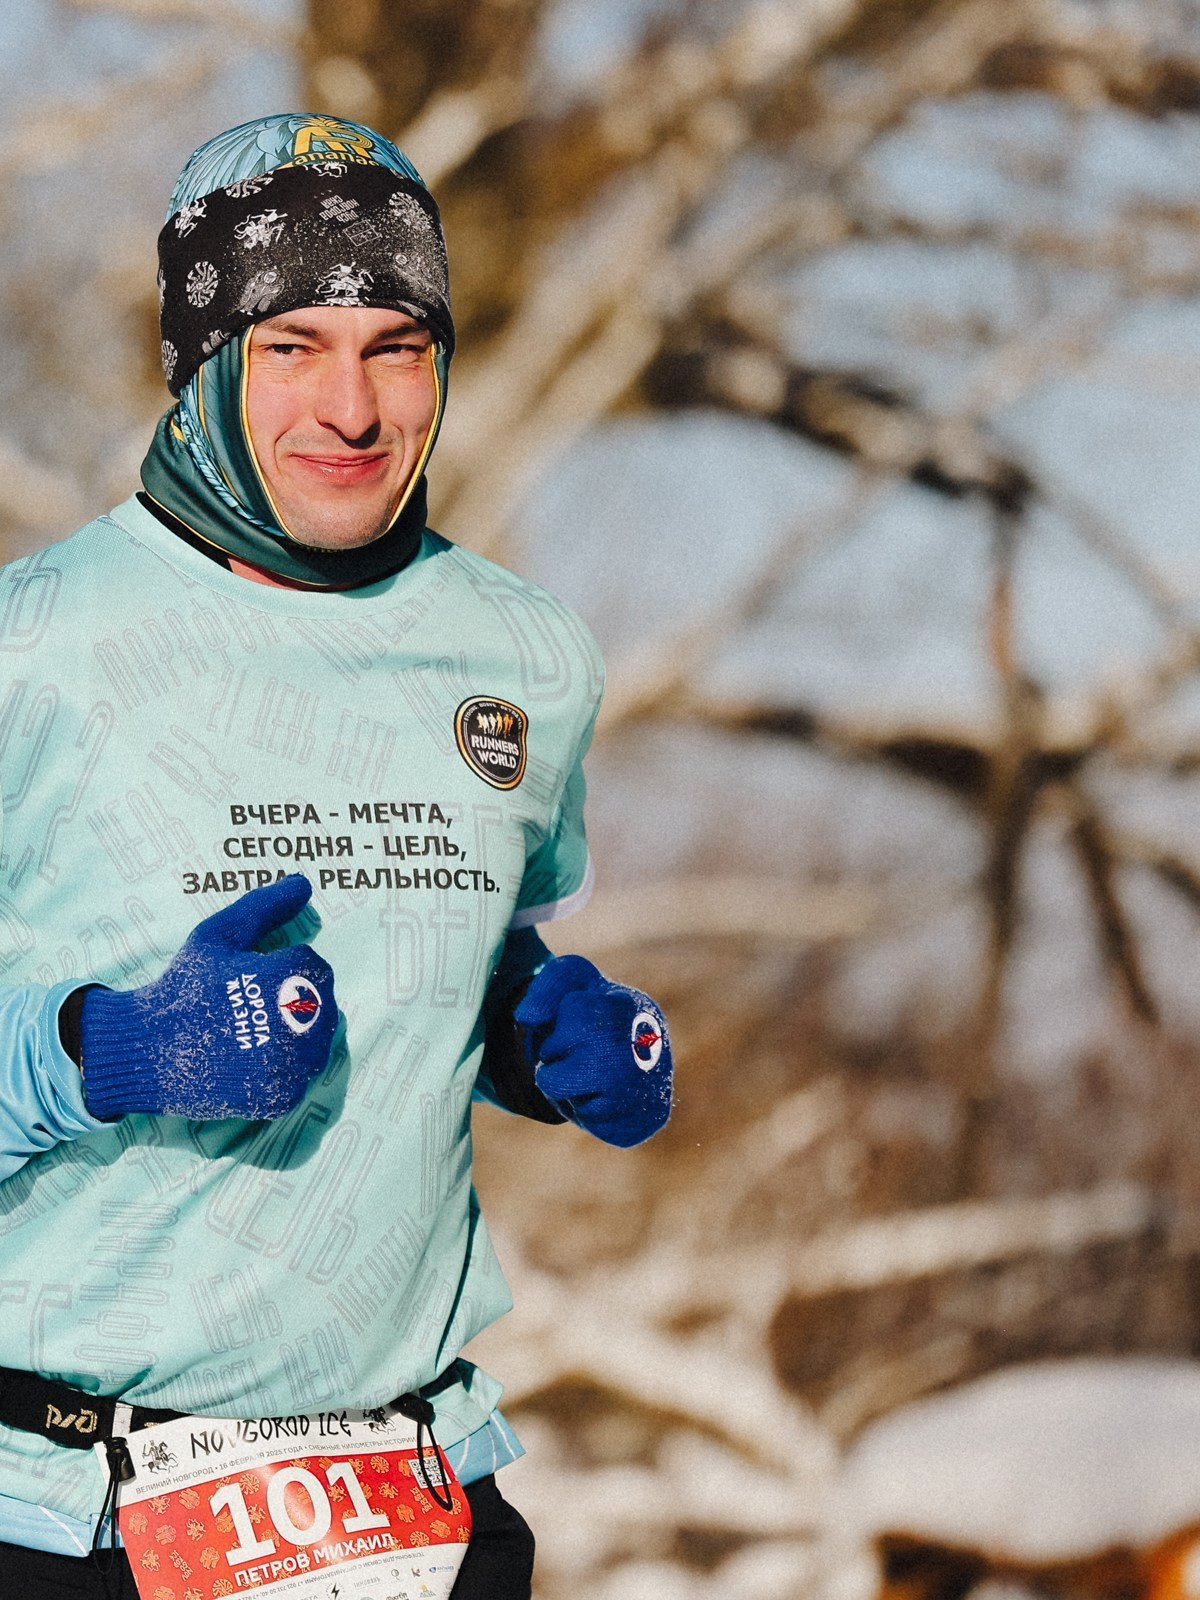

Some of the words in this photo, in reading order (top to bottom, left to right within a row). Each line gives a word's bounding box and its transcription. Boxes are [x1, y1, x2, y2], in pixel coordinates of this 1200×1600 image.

[470, 734, 519, 757] RUNNERS
[477, 749, 517, 769] WORLD
[230, 804, 321, 825] ВЧЕРА
[349, 803, 453, 829] МЕЧТА,
[223, 836, 354, 861] СЕГОДНЯ
[383, 835, 466, 862] ЦЕЛЬ,
[319, 868, 501, 894] РЕАЛЬНОСТЬ.
[226, 977, 253, 1050] ЖИЗНИ
[241, 973, 270, 1047] ДОРОГА
[319, 1410, 352, 1437] ICE
[135, 1476, 172, 1494] ВЕЛИКИЙ
[173, 1466, 214, 1484] НОВГОРОД
[266, 1449, 283, 1458] 2025
[284, 1445, 304, 1455] ГОДА
[341, 1440, 383, 1449] КИЛОМЕТРЫ
[209, 1462, 391, 1567] 101
[234, 1553, 311, 1587] ПЕТРОВ
[314, 1532, 396, 1563] МИХАИЛ
